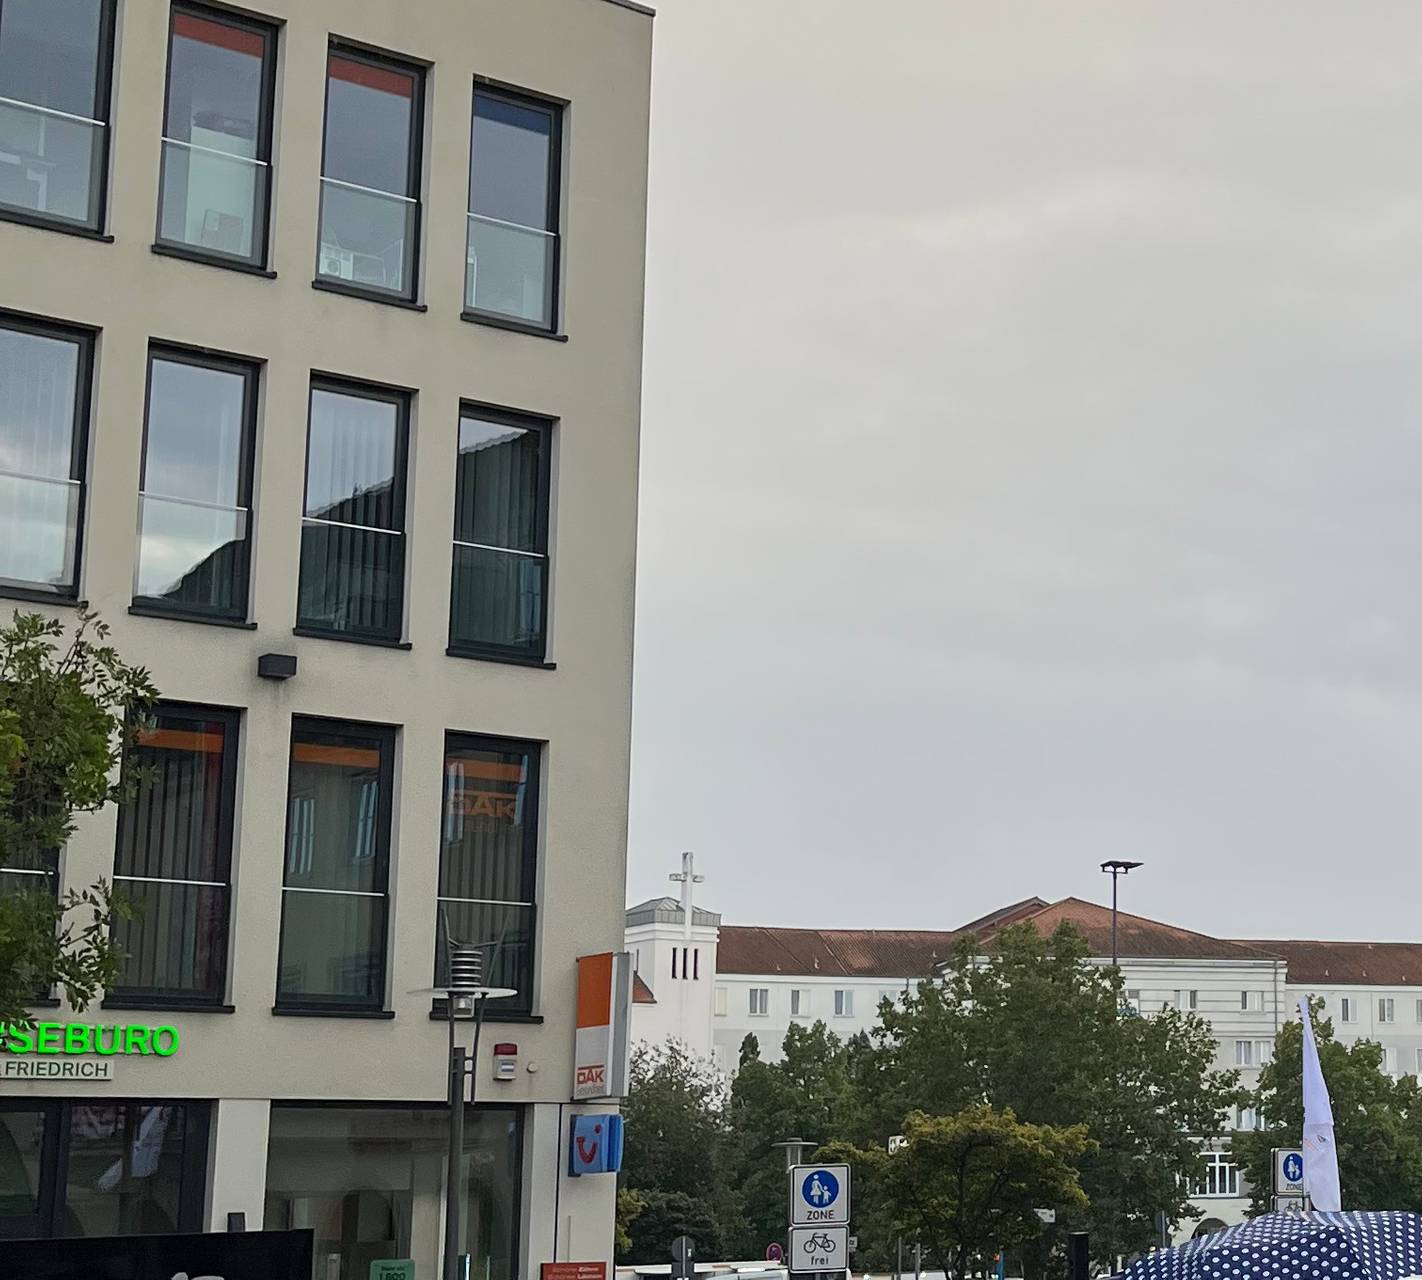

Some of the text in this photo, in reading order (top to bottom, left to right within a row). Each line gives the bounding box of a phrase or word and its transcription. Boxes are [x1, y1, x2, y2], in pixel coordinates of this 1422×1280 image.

[5, 1061, 109, 1077] FRIEDRICH
[577, 1065, 605, 1085] DAK
[806, 1209, 835, 1221] ZONE
[810, 1255, 829, 1265] frei
